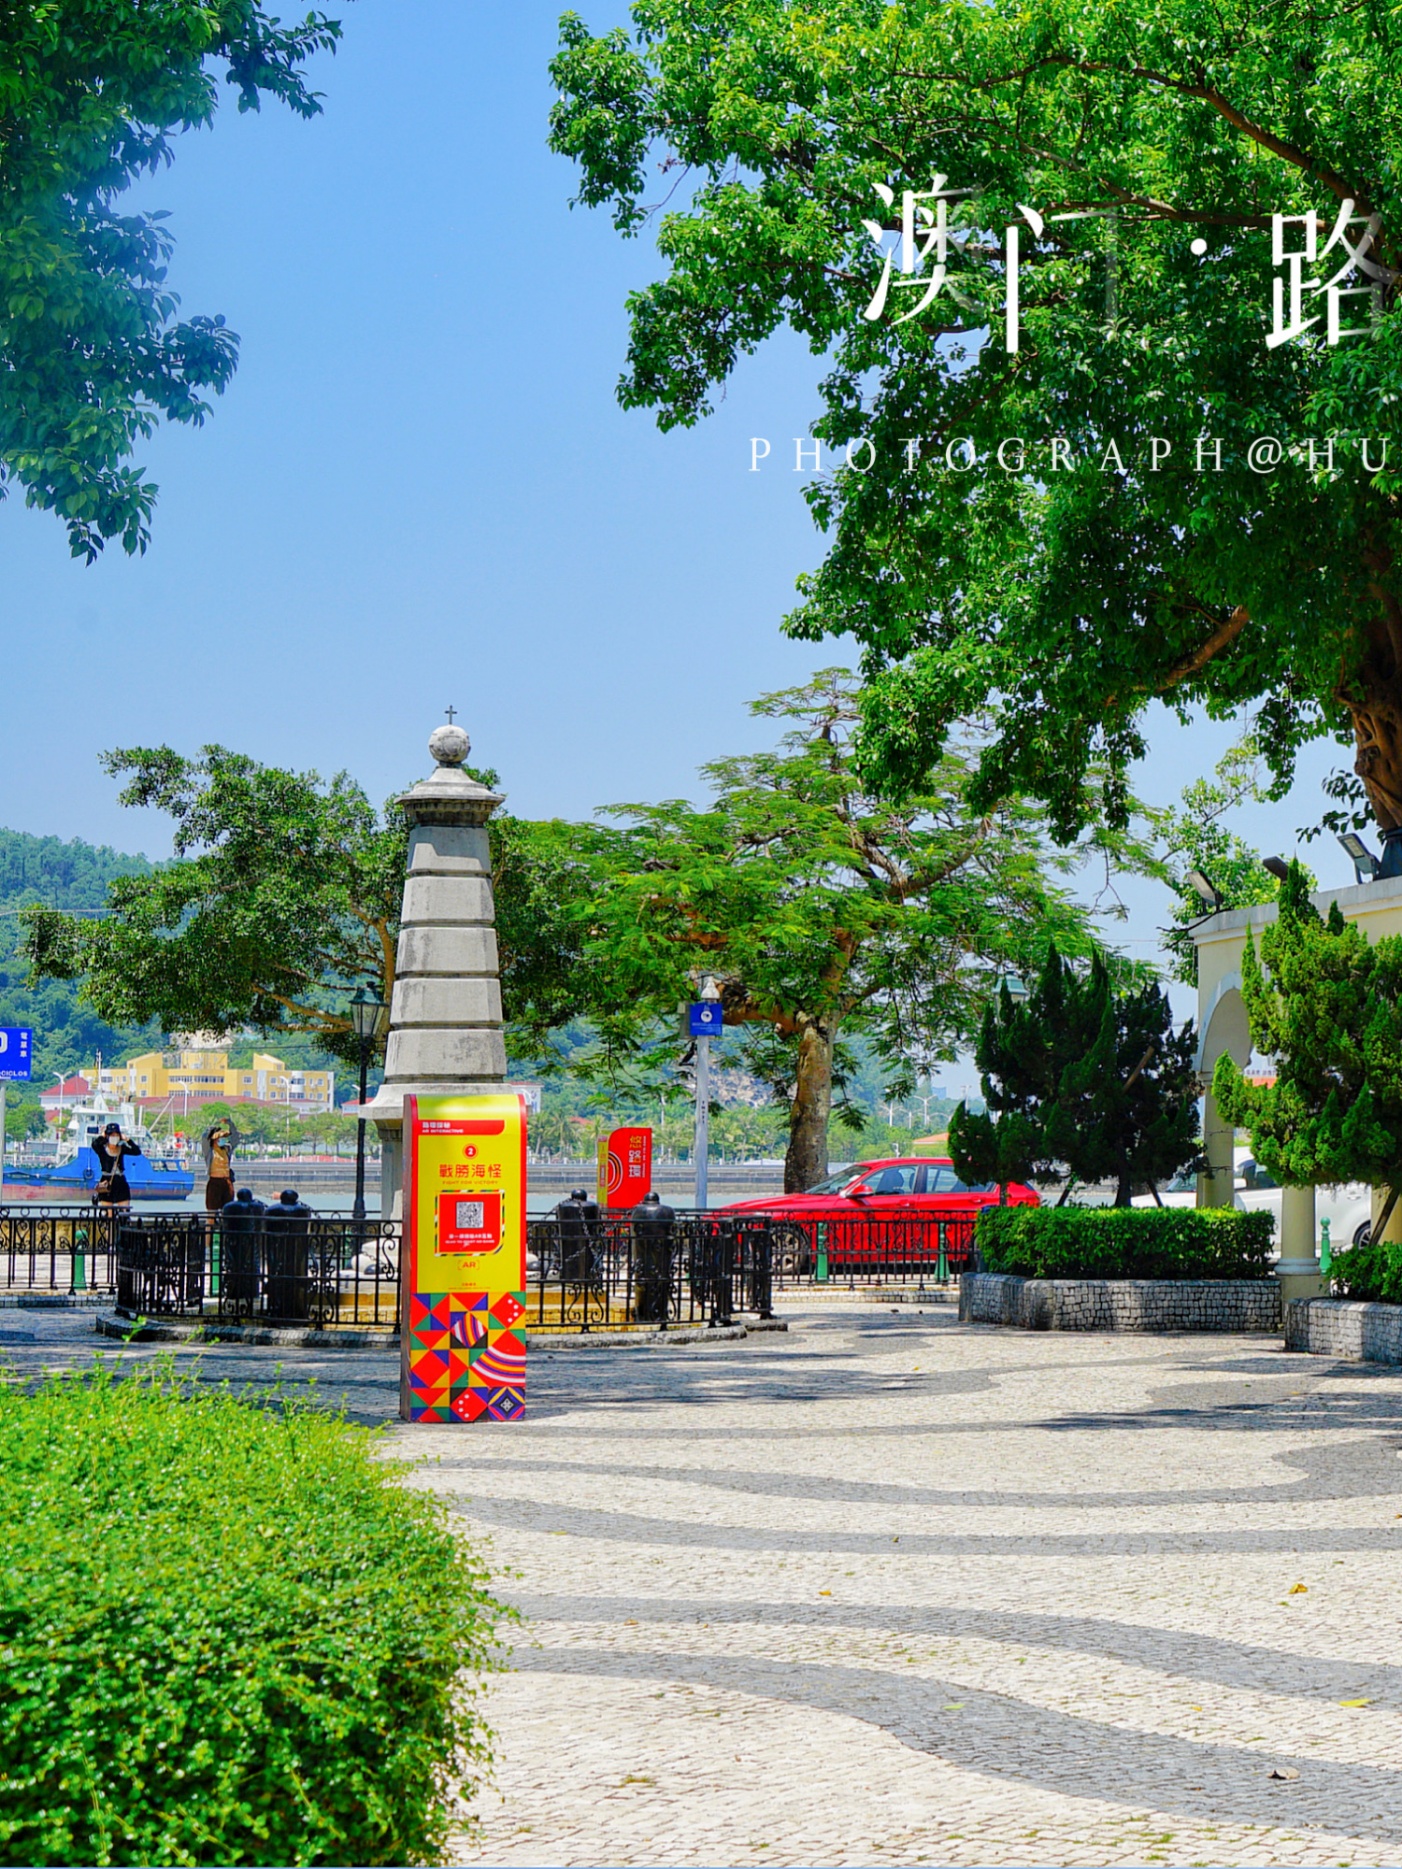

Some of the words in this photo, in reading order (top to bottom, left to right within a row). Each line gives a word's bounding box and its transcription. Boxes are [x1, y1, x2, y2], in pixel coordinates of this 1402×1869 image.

[468, 1147, 474, 1155] 2
[439, 1164, 501, 1178] 戰勝海怪
